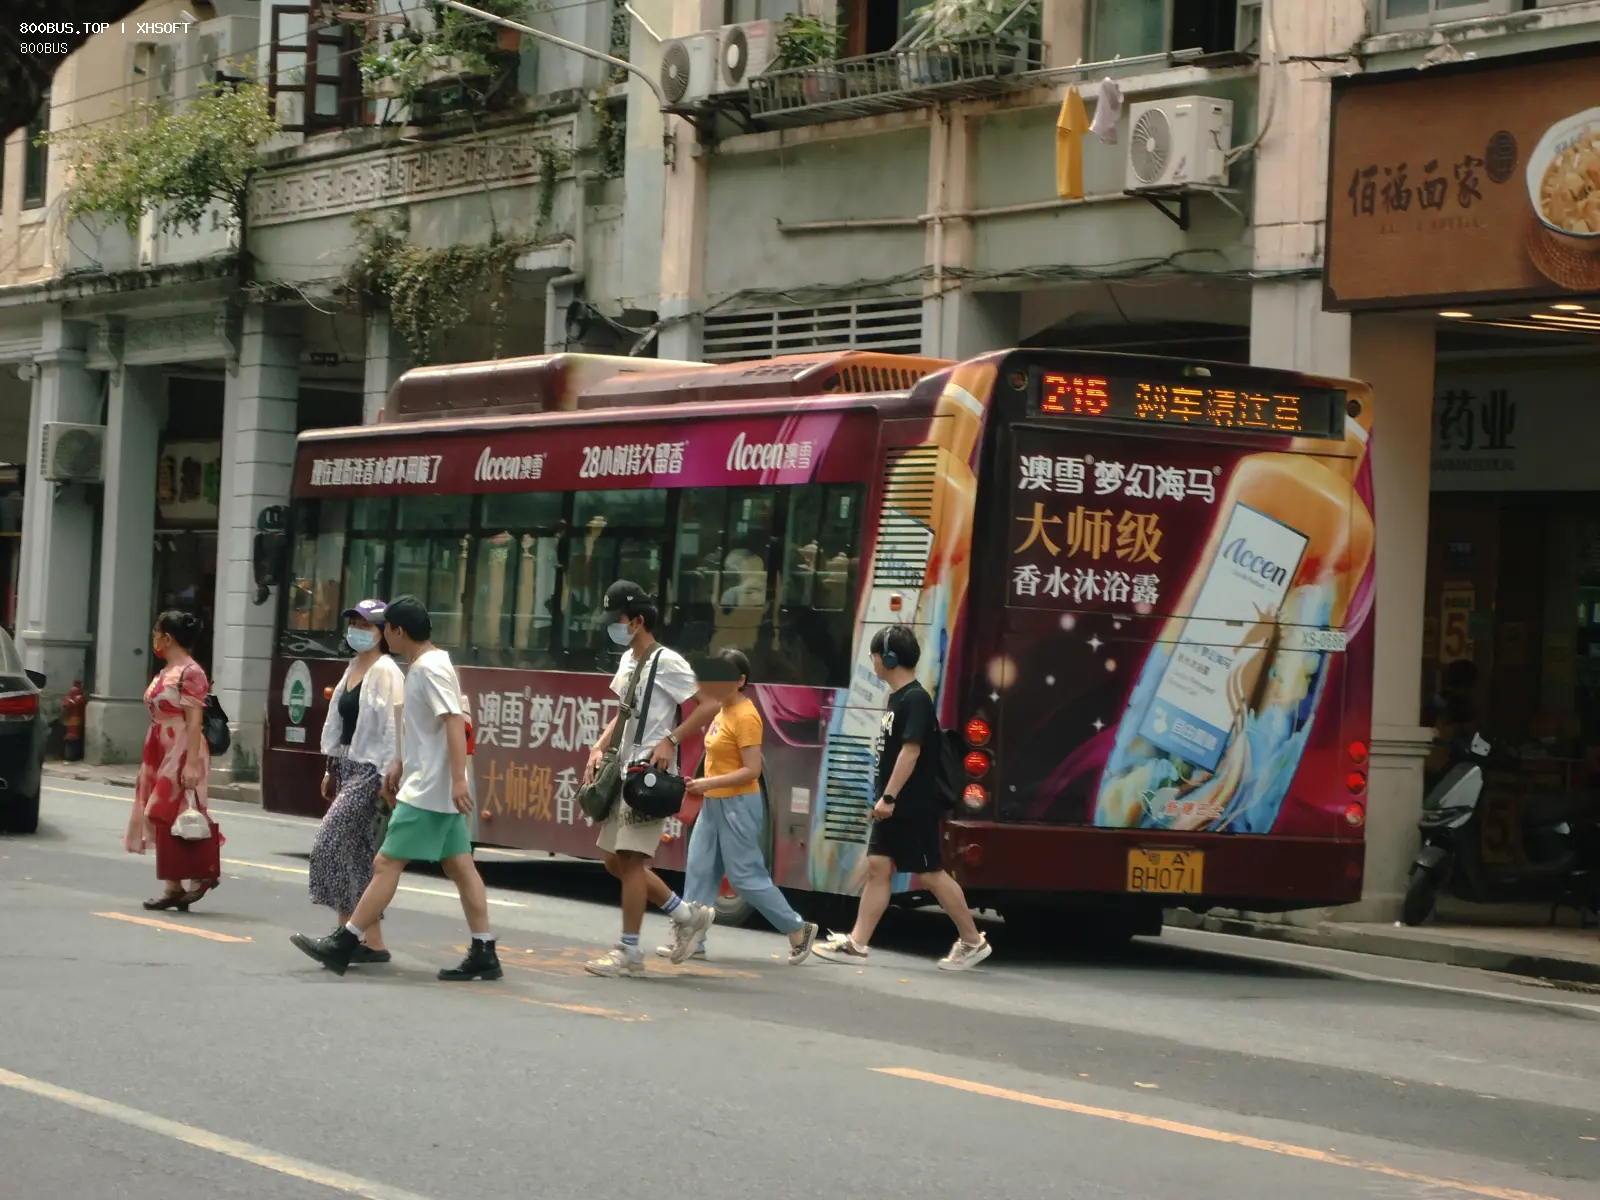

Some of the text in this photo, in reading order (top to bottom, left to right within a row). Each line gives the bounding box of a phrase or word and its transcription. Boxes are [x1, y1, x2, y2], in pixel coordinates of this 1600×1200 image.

[1439, 388, 1517, 451] 药业
[1014, 502, 1163, 564] 大师级
[1012, 563, 1161, 605] 香水沐浴露
[1222, 537, 1288, 587] Accen
[1131, 866, 1195, 891] BH071
